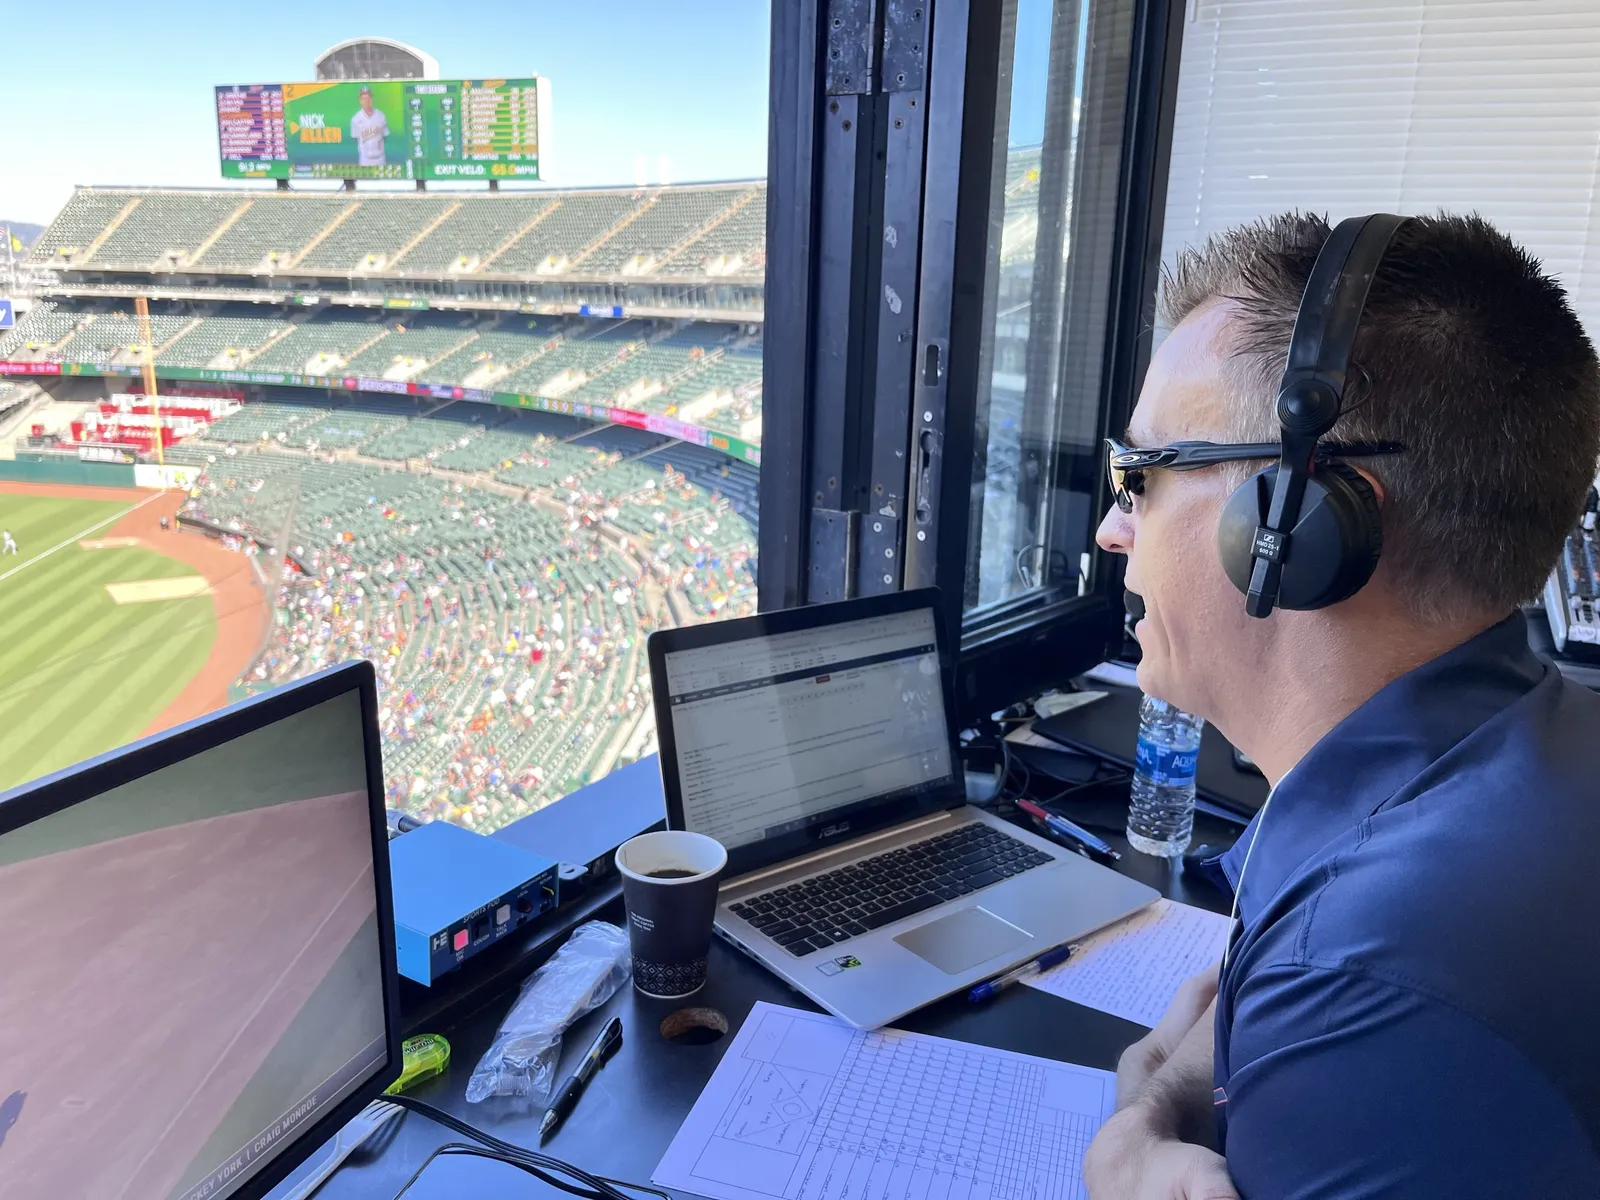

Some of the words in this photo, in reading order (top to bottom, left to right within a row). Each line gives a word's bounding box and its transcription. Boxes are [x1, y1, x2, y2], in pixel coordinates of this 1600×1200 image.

[819, 821, 850, 839] ASUS
[463, 906, 487, 924] SPORTS
[217, 1157, 243, 1182] YORK
[254, 1125, 281, 1153] CRAIG
[282, 1094, 318, 1129] MONROE
